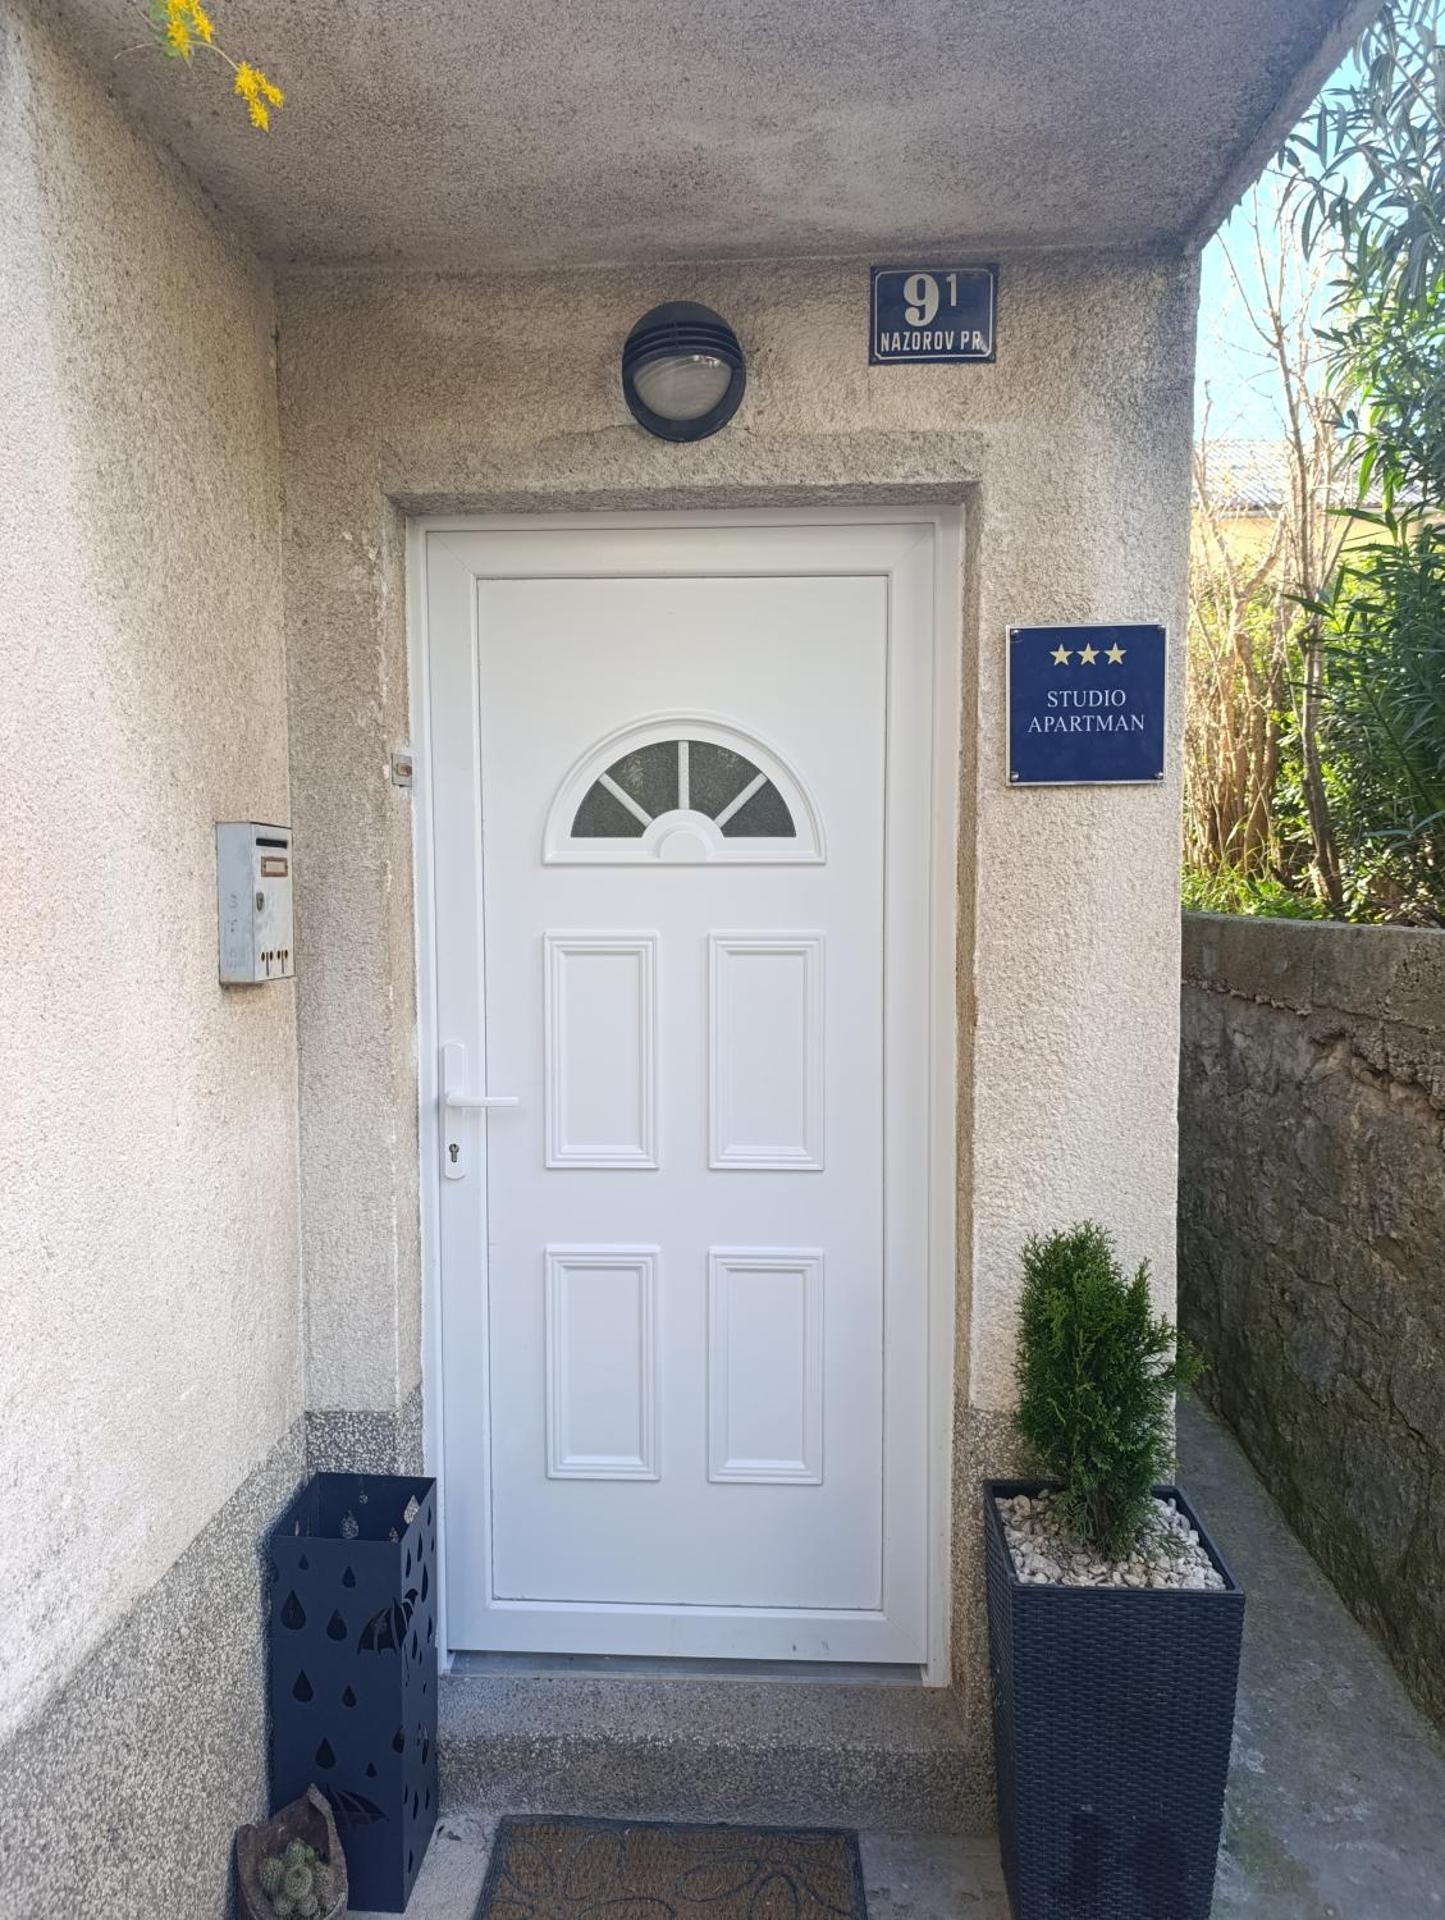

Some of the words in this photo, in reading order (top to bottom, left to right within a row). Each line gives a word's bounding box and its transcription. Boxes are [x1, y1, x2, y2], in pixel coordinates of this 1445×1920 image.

[881, 331, 954, 352] NAZOROV
[1047, 689, 1126, 708] STUDIO
[1028, 714, 1145, 733] APARTMAN
